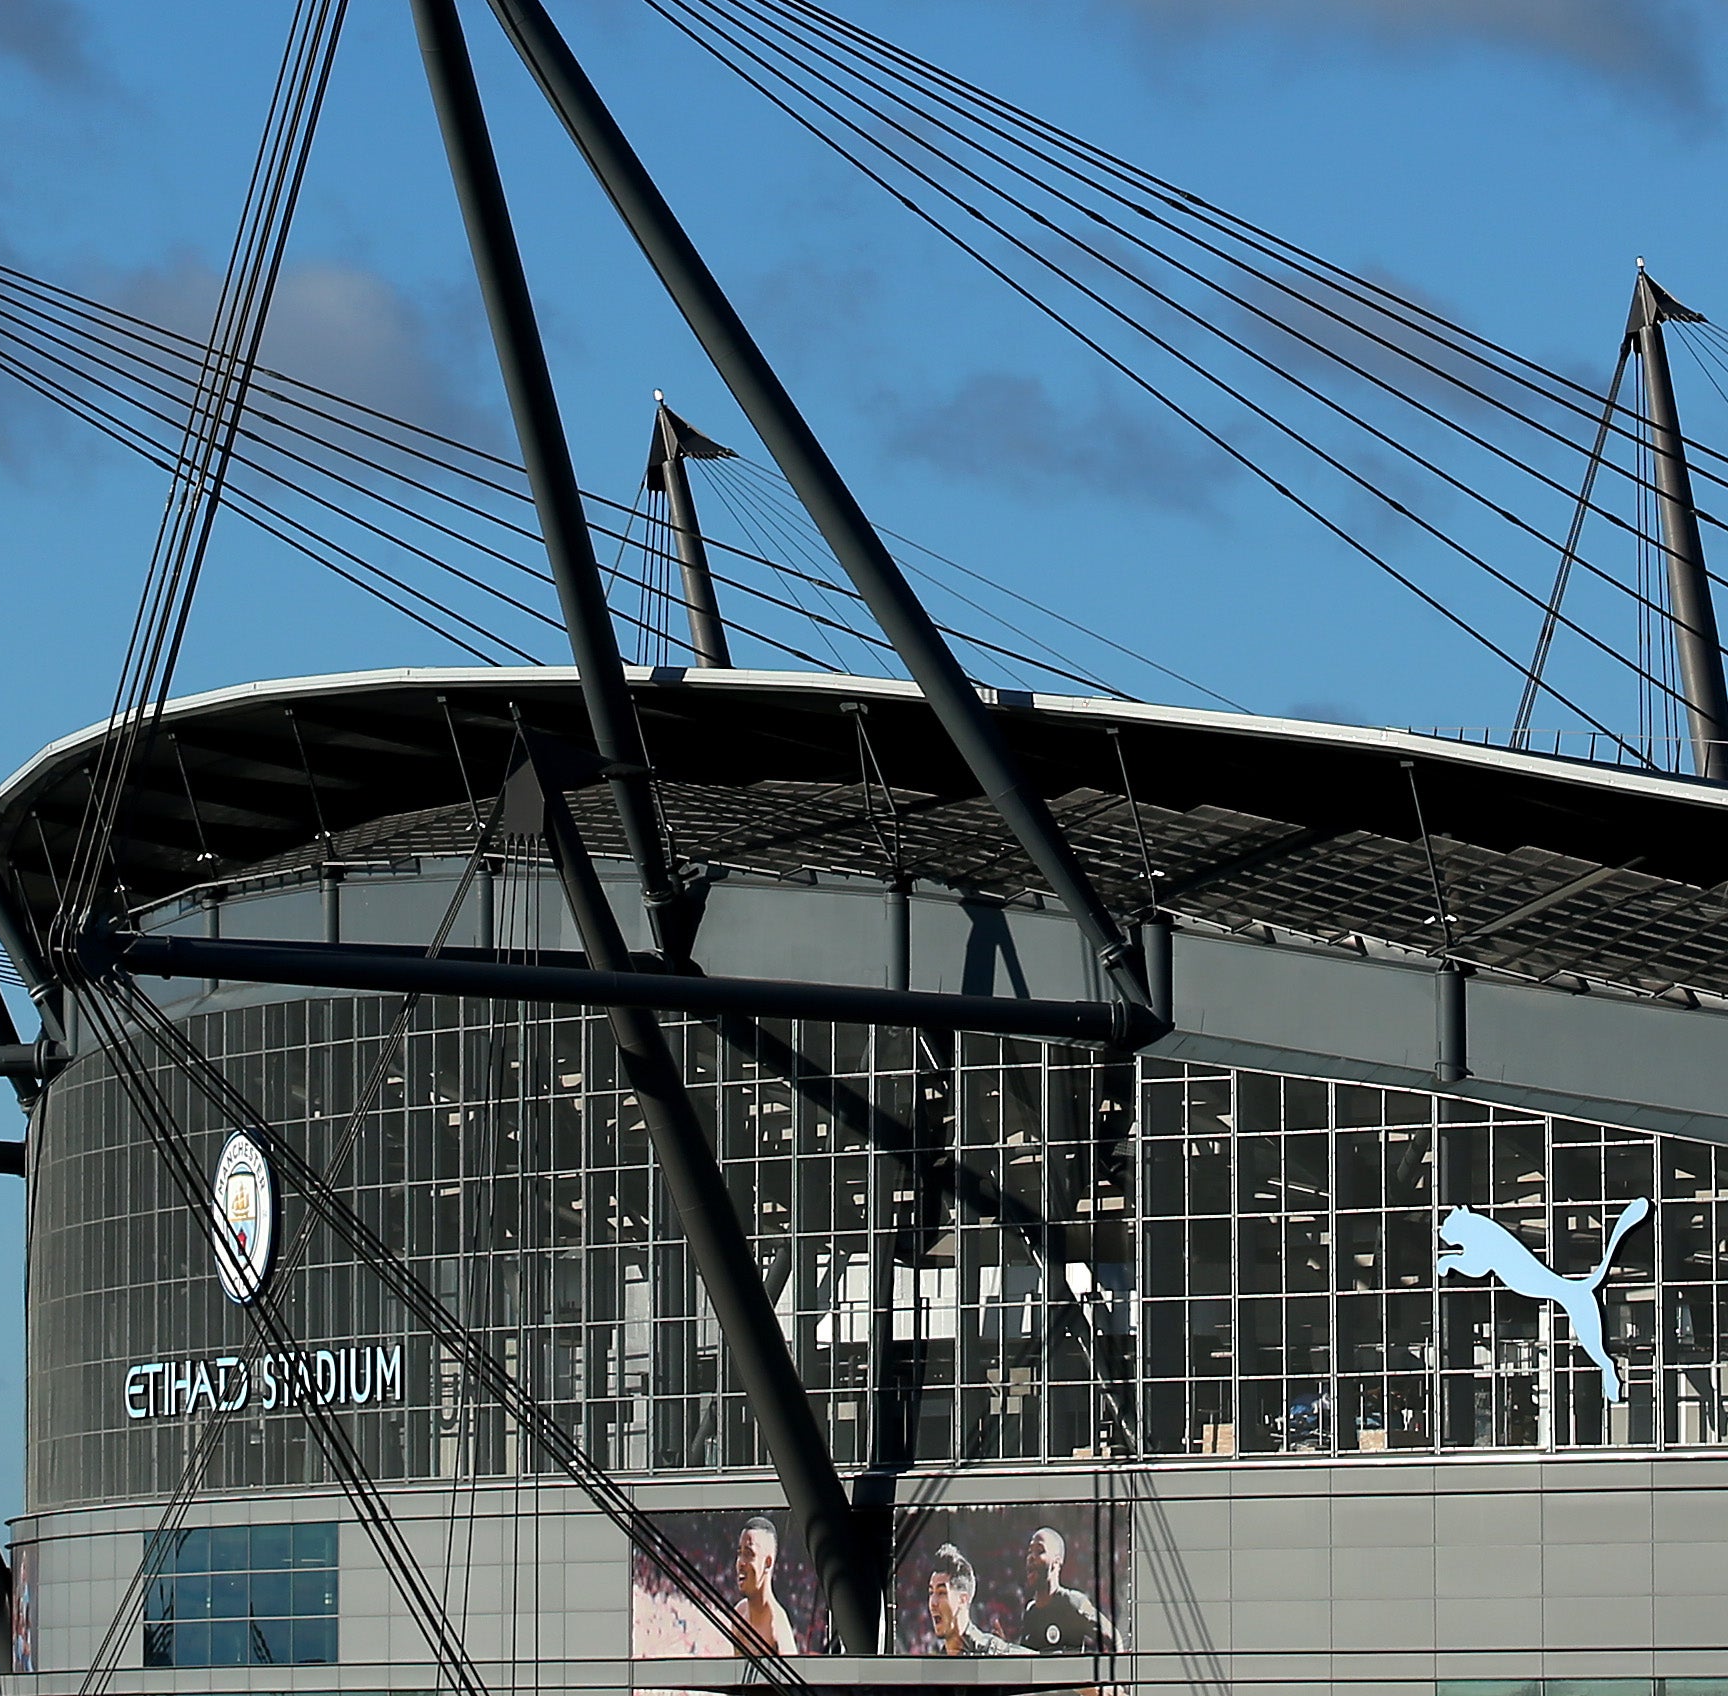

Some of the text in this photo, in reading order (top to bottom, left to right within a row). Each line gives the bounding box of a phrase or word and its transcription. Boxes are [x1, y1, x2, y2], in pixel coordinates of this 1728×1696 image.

[218, 1141, 265, 1195] MANCHESTER
[124, 1345, 401, 1418] ETIHAD STADIUM
